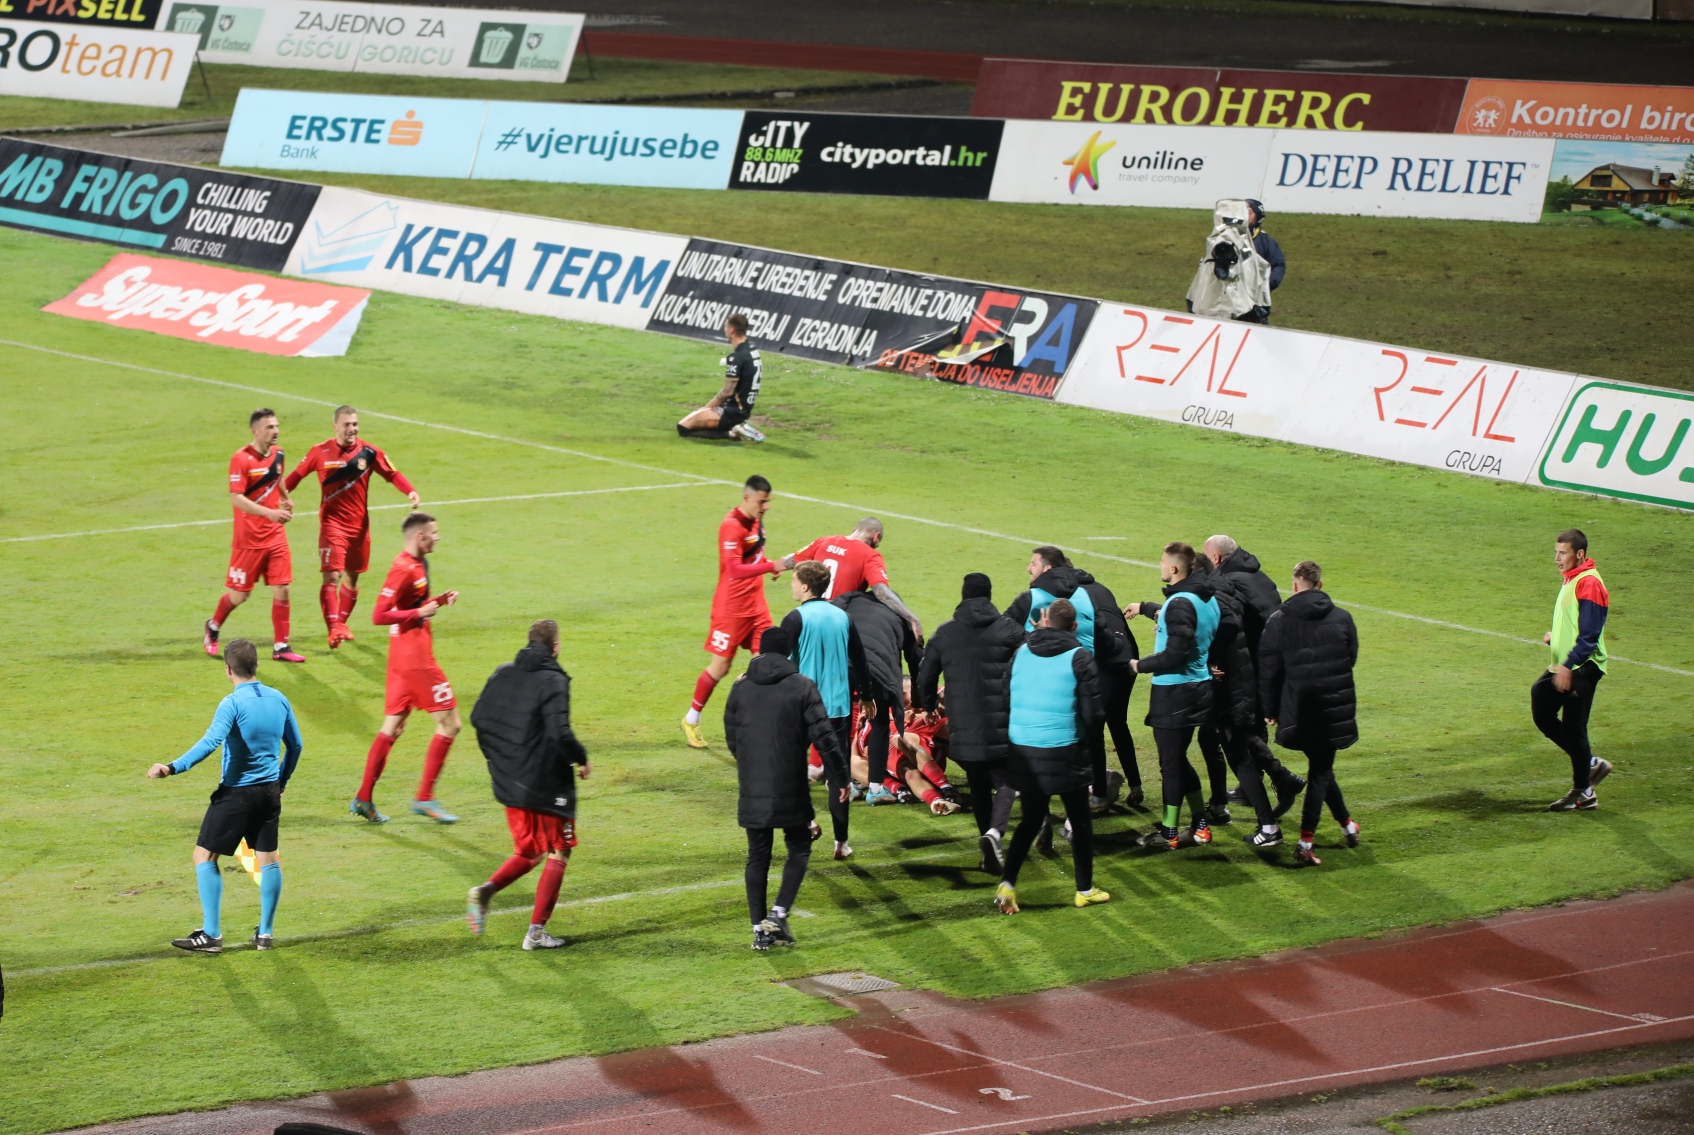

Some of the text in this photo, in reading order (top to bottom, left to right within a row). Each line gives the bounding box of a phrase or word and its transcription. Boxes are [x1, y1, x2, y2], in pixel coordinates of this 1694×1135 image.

[26, 0, 146, 22] PIXSELL
[294, 11, 446, 39] ZAJEDNO ZA
[276, 32, 455, 66] ČIŠĆU GORICU
[1052, 81, 1371, 131] EUROHERC
[1510, 99, 1632, 129] Kontrol
[285, 114, 386, 144] ERSTE
[494, 127, 720, 161] #vjerujusebe
[748, 120, 810, 149] CITY
[280, 144, 320, 159] Bank
[820, 142, 987, 169] cityportal.hr
[1122, 150, 1204, 171] uniline
[0, 153, 190, 226] MB FRIGO
[1118, 173, 1200, 185] travel company
[1276, 152, 1379, 190] DEEP
[1386, 157, 1527, 196] RELIEF
[196, 182, 272, 214] CHILLING
[185, 208, 294, 245] YOUR WORLD
[171, 236, 227, 259] SINCE 1981
[384, 223, 671, 309] KERA TERM
[676, 250, 977, 324] UNUTARNJE UREĐENJE OPREMANJE DOMA
[76, 265, 339, 342] SuperSport
[653, 291, 878, 357] KUĆANSKI EĐAJI IZGRADNJA
[899, 351, 959, 380] TEMLJA
[956, 363, 981, 385] DO
[1115, 309, 1252, 399] REAL
[1373, 349, 1520, 443] REAL
[1181, 404, 1236, 430] GRUPA
[1562, 403, 1694, 483] HU
[1445, 449, 1503, 476] GRUPA
[826, 544, 848, 557] SUK
[228, 566, 247, 586] 44
